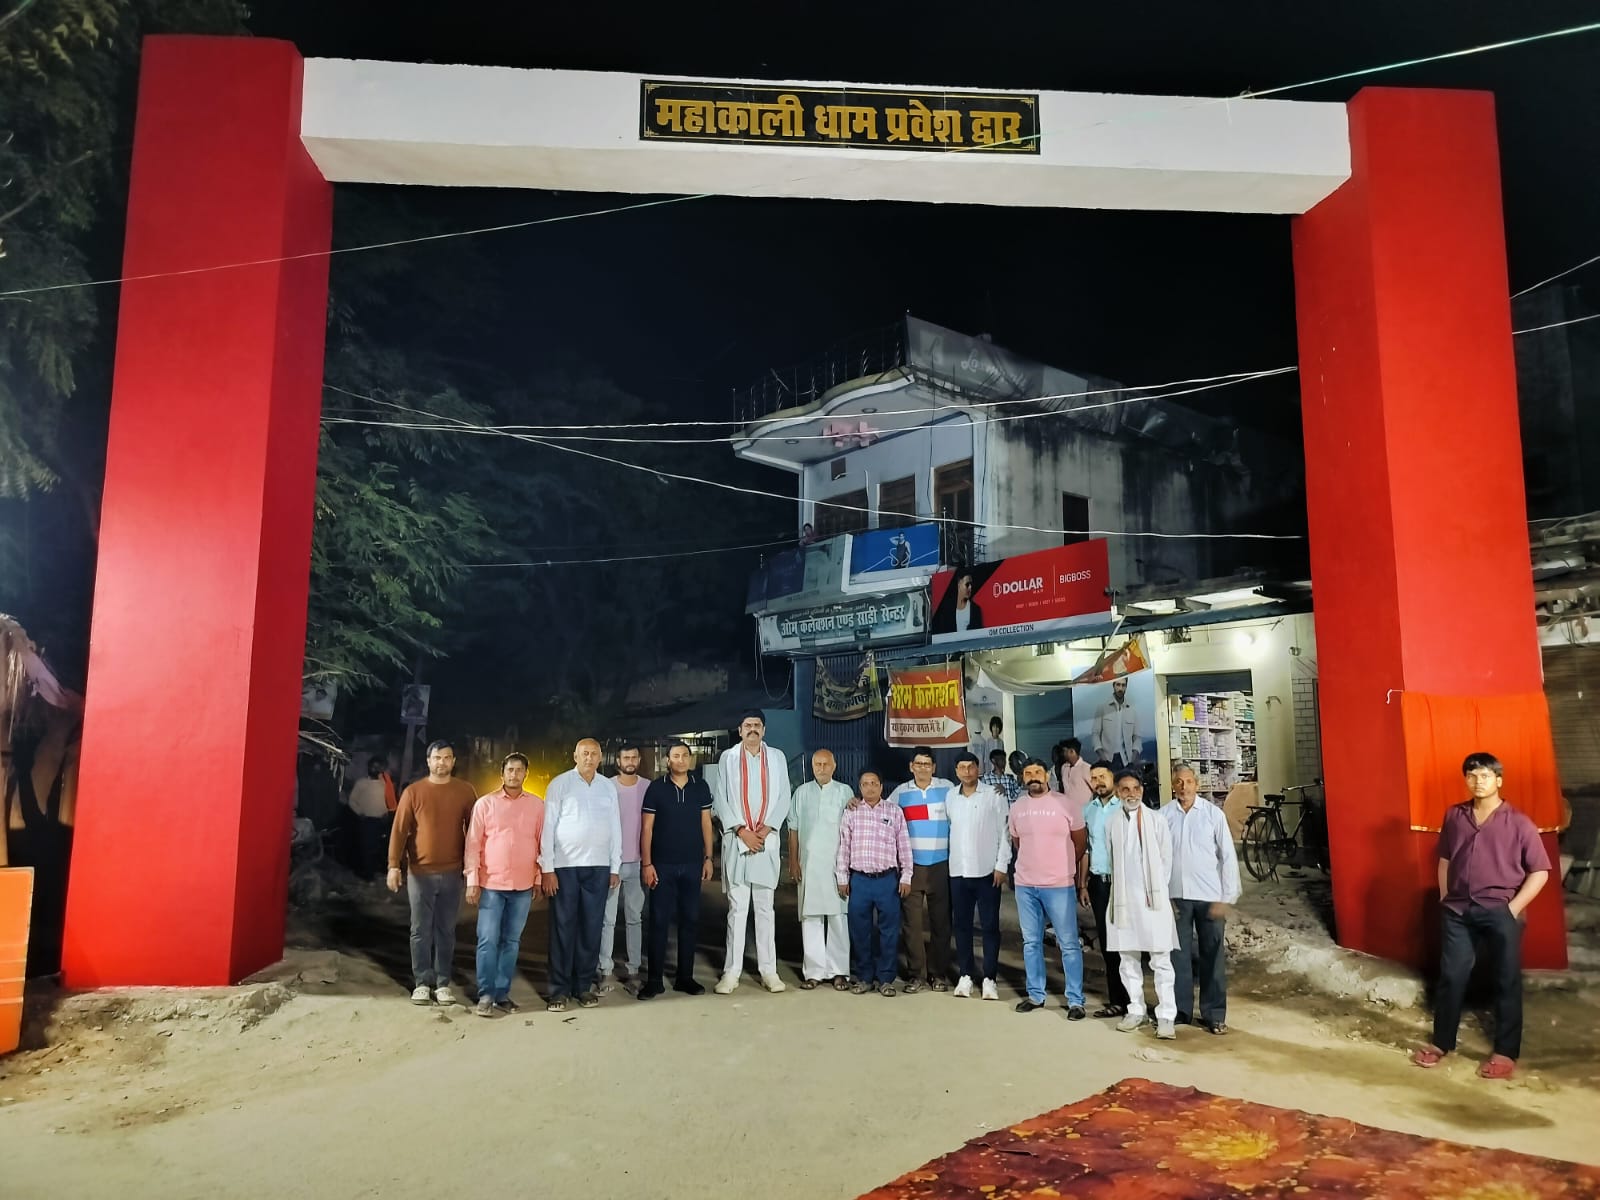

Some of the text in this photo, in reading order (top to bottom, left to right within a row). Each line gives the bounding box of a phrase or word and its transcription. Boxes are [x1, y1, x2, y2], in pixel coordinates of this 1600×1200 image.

[655, 95, 1022, 145] महाकाली धाम प्रवेश द्वार
[1003, 577, 1044, 595] DOLLAR
[1059, 570, 1092, 584] BIGBOSS
[781, 618, 799, 637] ओम
[836, 613, 854, 629] एण्ड
[881, 603, 906, 623] सेन्टर
[998, 624, 1034, 635] COLLECTION
[891, 677, 913, 710] ओम
